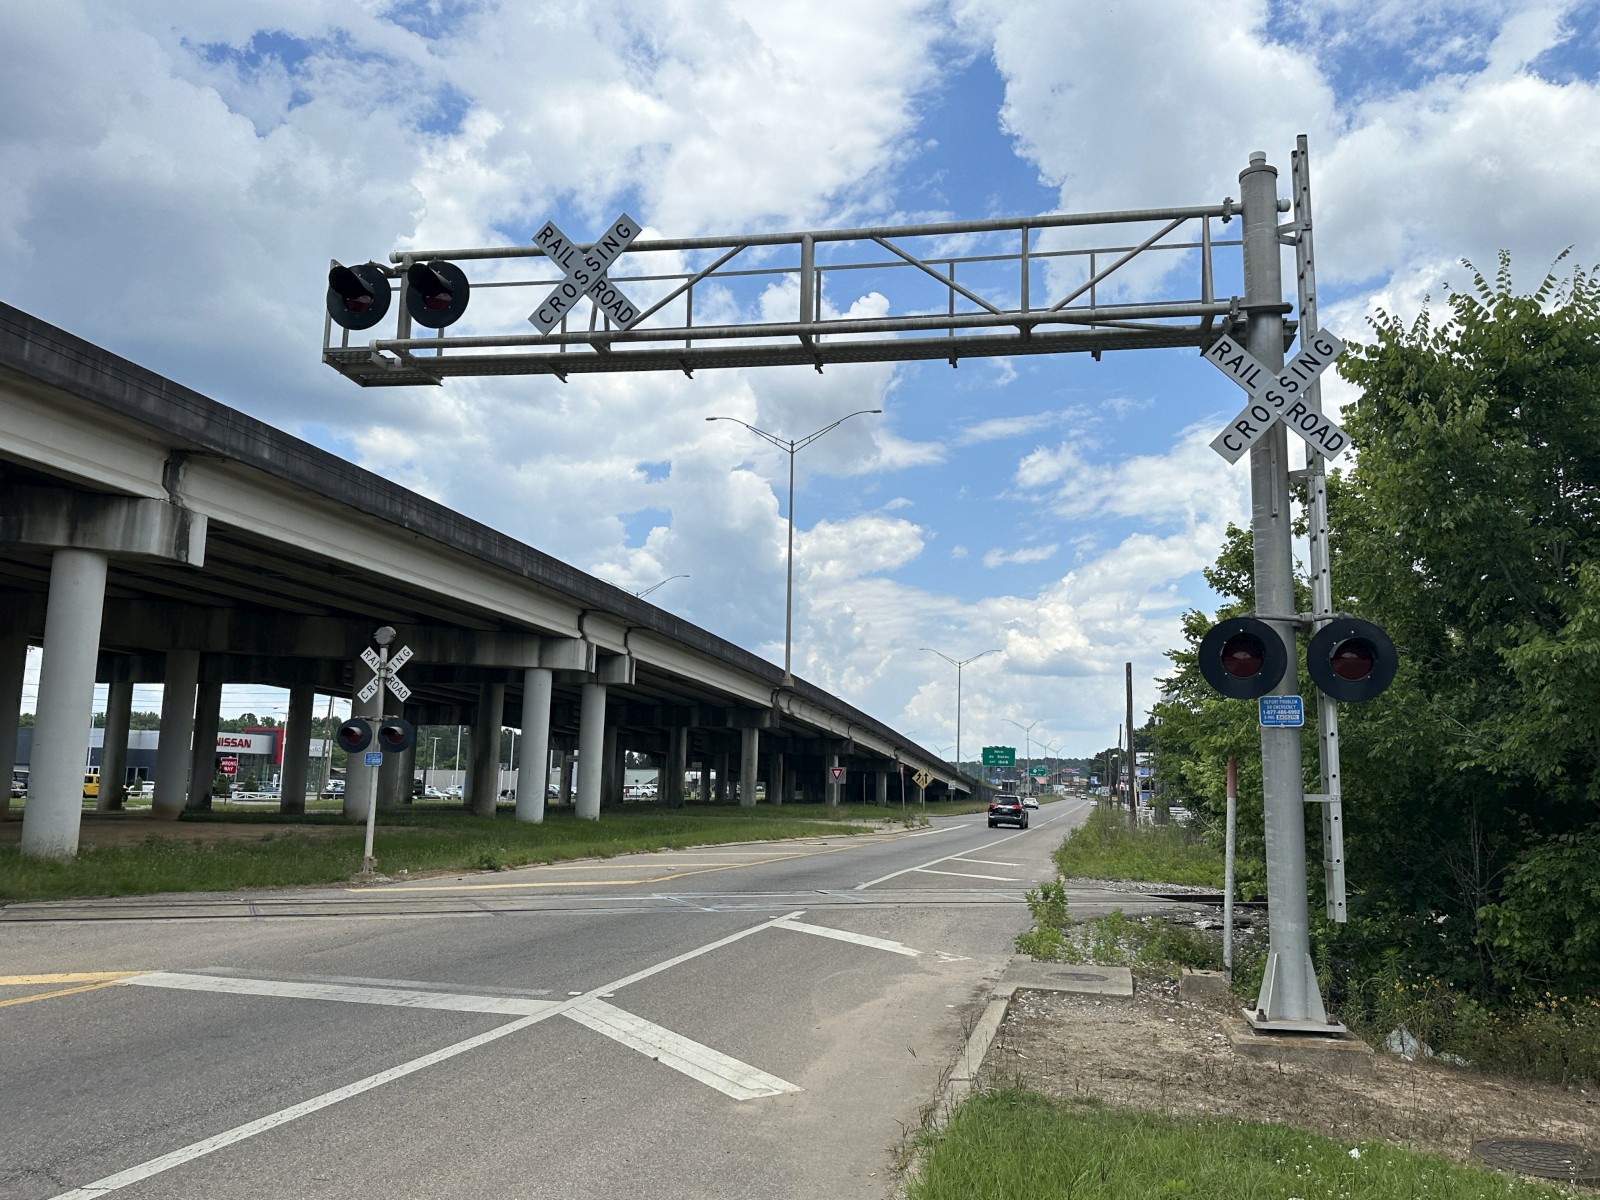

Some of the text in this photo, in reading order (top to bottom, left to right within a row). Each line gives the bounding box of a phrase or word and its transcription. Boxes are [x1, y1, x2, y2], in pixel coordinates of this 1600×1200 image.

[537, 225, 634, 323] RAIL ROAD
[538, 223, 631, 324] CROSSING
[1211, 340, 1344, 452] RAIL ROAD
[1223, 339, 1334, 452] CROSSING
[386, 676, 408, 699] ROAD
